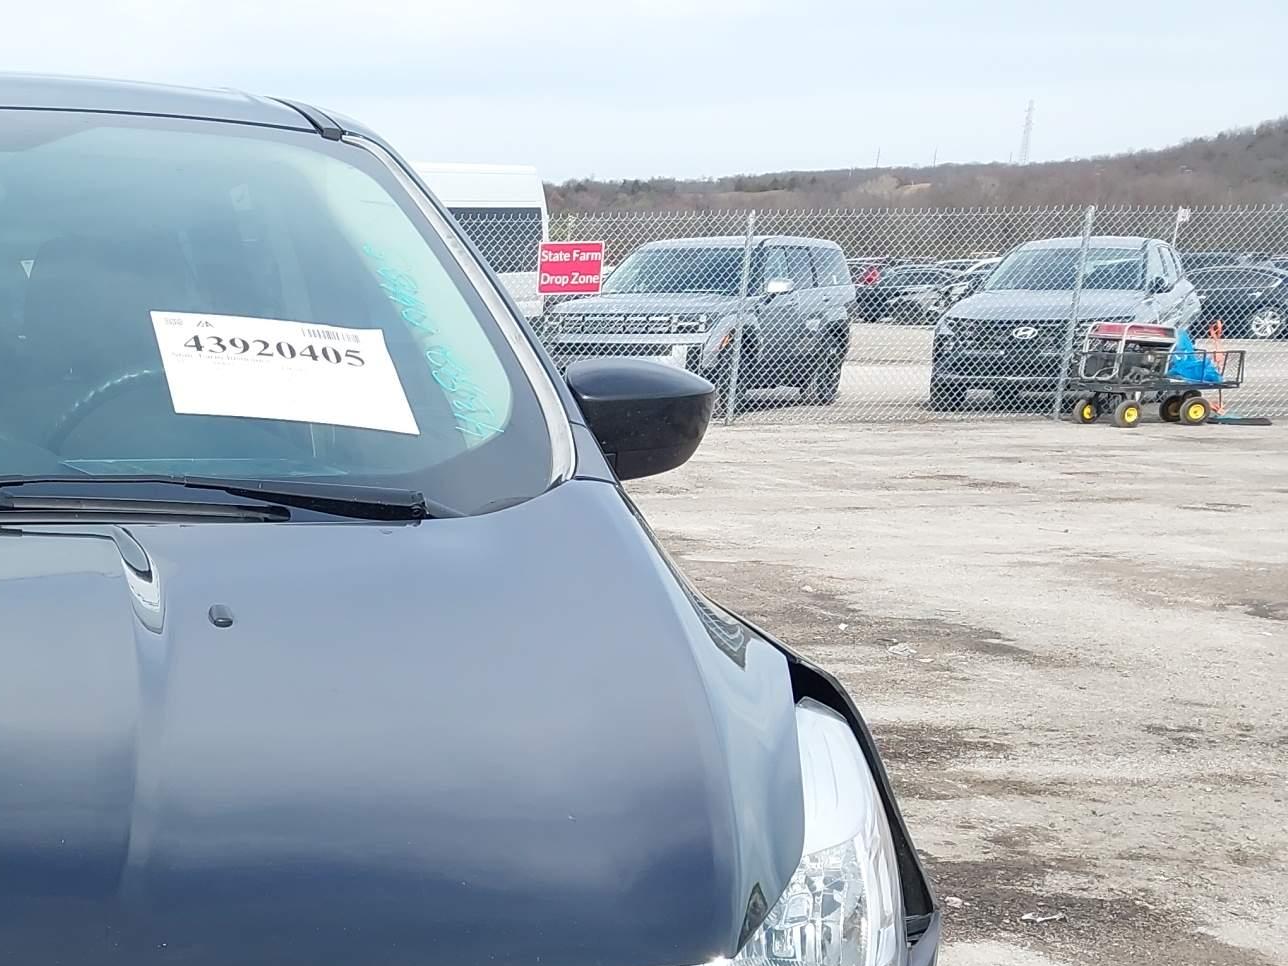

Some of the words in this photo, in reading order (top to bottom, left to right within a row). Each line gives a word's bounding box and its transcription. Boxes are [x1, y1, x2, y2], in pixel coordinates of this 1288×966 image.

[541, 250, 570, 261] State
[573, 249, 601, 261] Farm
[540, 272, 569, 286] Drop
[570, 272, 600, 284] Zone
[183, 334, 365, 367] 43920405
